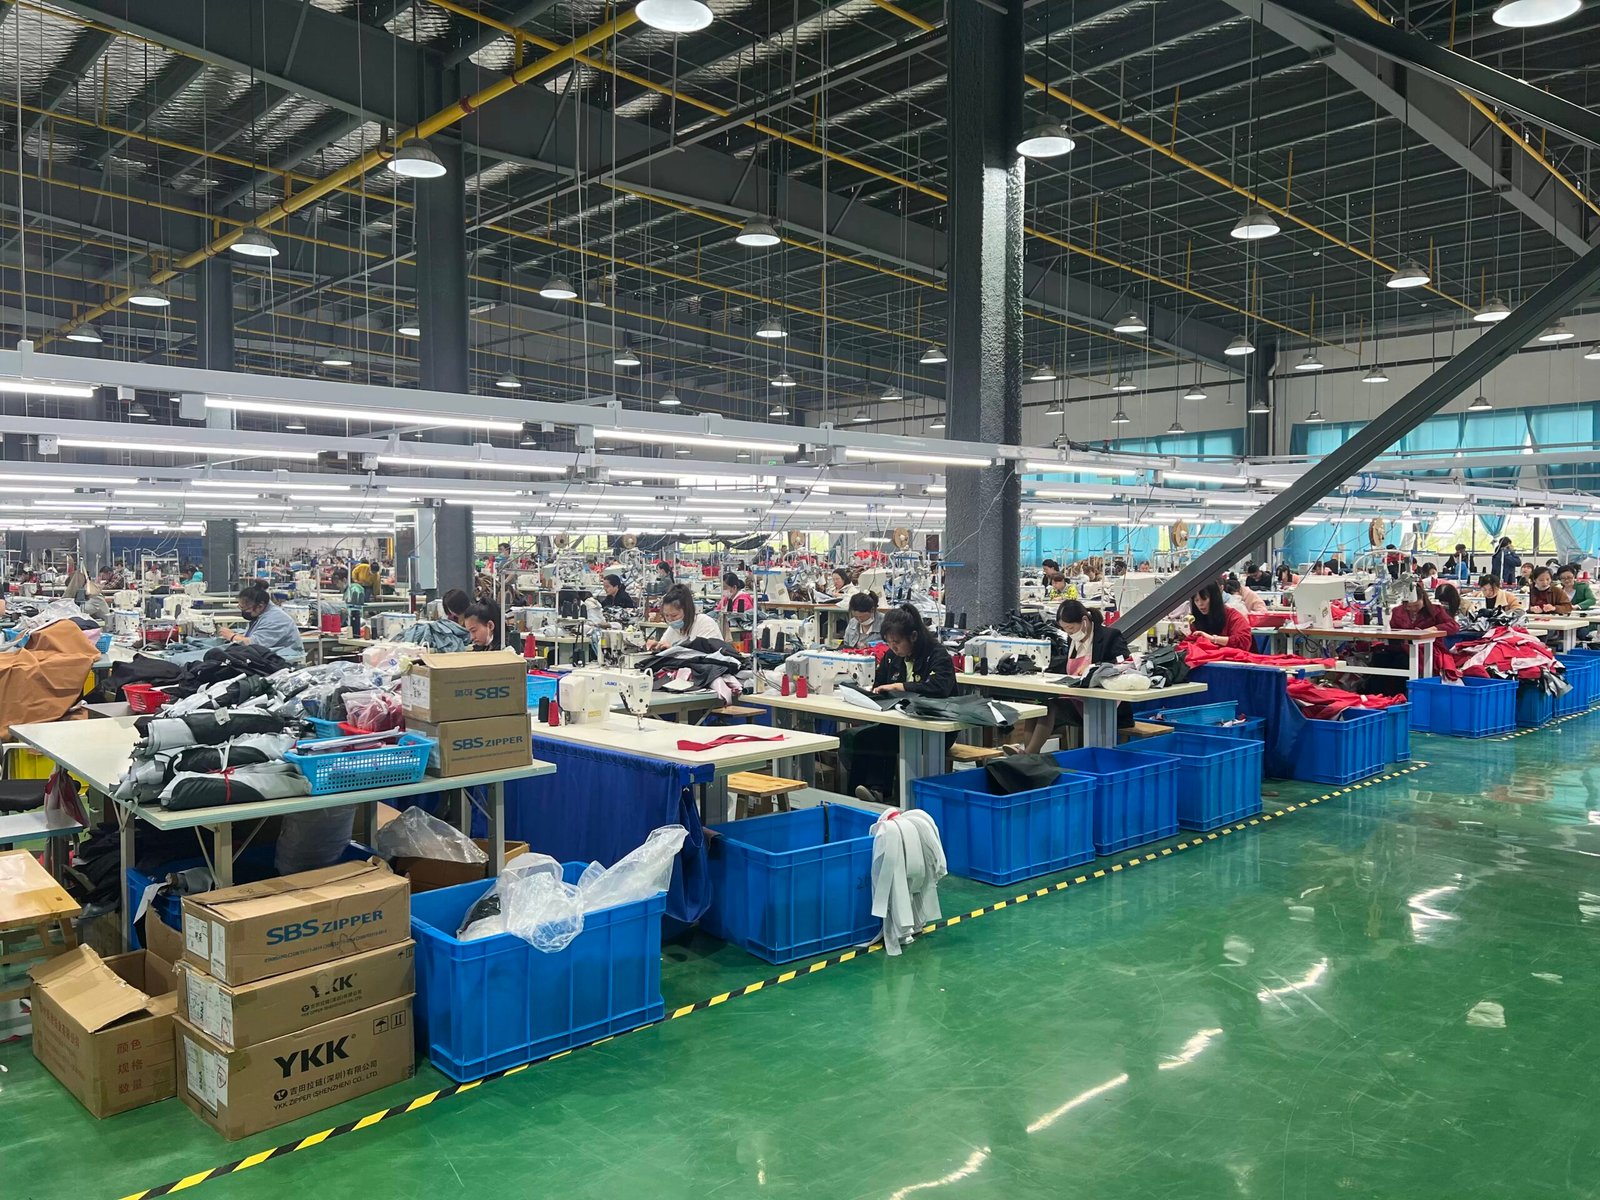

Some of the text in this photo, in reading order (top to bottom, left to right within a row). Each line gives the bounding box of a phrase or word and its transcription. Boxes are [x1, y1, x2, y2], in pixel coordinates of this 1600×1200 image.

[474, 686, 510, 700] SBS
[452, 735, 523, 751] SBS ZIPPER
[266, 918, 319, 946] SBS
[321, 909, 383, 934] ZIPPER
[274, 1035, 349, 1078] YKK
[273, 1101, 288, 1111] YKK
[289, 1093, 312, 1106] ZIPPER
